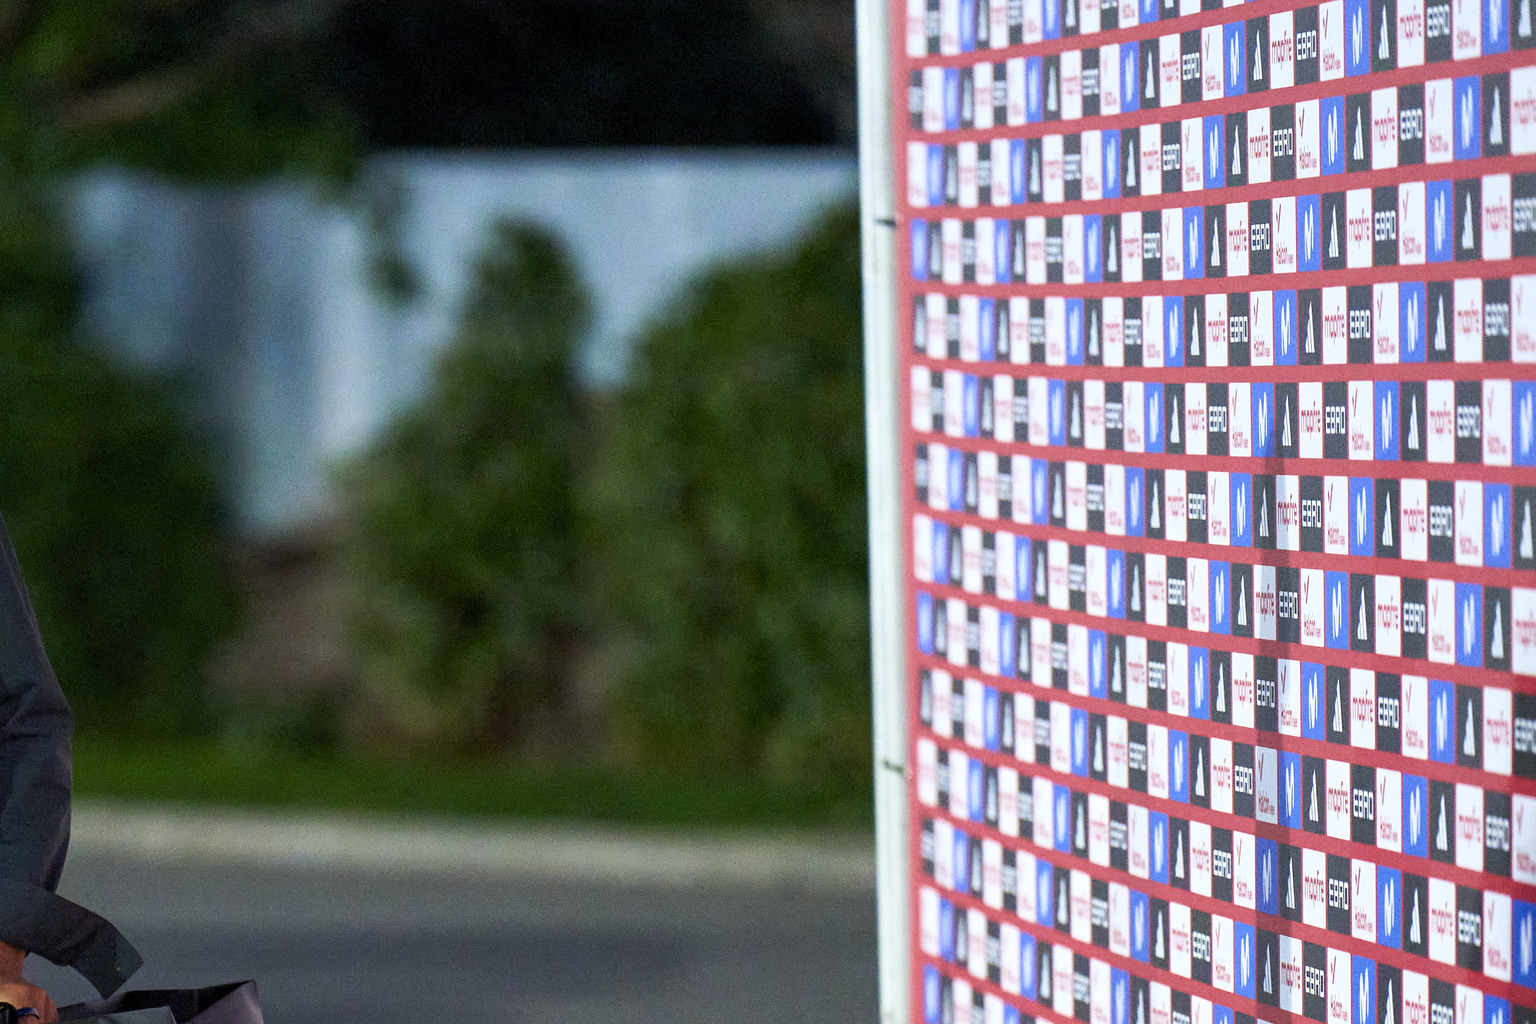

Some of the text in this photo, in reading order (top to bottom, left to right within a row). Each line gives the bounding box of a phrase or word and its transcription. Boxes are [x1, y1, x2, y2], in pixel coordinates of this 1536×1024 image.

[1272, 30, 1291, 69] mapfre
[1296, 29, 1316, 60] EBRO
[1374, 108, 1395, 148] mapfre
[1400, 108, 1422, 139] EBRO
[1249, 126, 1268, 164] mapfre
[1273, 127, 1292, 157] EBRO
[1228, 220, 1246, 257] mapfre
[1250, 222, 1269, 251] EBRO
[1349, 208, 1369, 248] mapfre
[1374, 210, 1396, 240] EBRO
[1229, 315, 1248, 343] EBRO
[1324, 306, 1344, 345] mapfre
[1349, 309, 1370, 338] EBRO
[1208, 405, 1226, 432] EBRO
[1301, 401, 1320, 439] mapfre
[1325, 406, 1345, 434] EBRO
[1278, 493, 1296, 531] mapfre
[1301, 499, 1321, 527] EBRO
[1255, 583, 1274, 621] mapfre
[1278, 590, 1298, 619] EBRO
[1377, 596, 1398, 635] mapfre
[1403, 602, 1425, 633] EBRO
[1234, 671, 1251, 708] mapfre
[1256, 678, 1275, 708] EBRO
[1352, 689, 1372, 727] mapfre
[1378, 696, 1399, 728] EBRO
[1234, 764, 1252, 795] EBRO
[1328, 780, 1348, 819] mapfre
[1353, 788, 1373, 820] EBRO
[1213, 848, 1231, 879] EBRO
[1304, 869, 1323, 907] mapfre
[1328, 877, 1348, 910] EBRO
[1281, 956, 1300, 993] mapfre
[1305, 964, 1324, 998] EBRO
